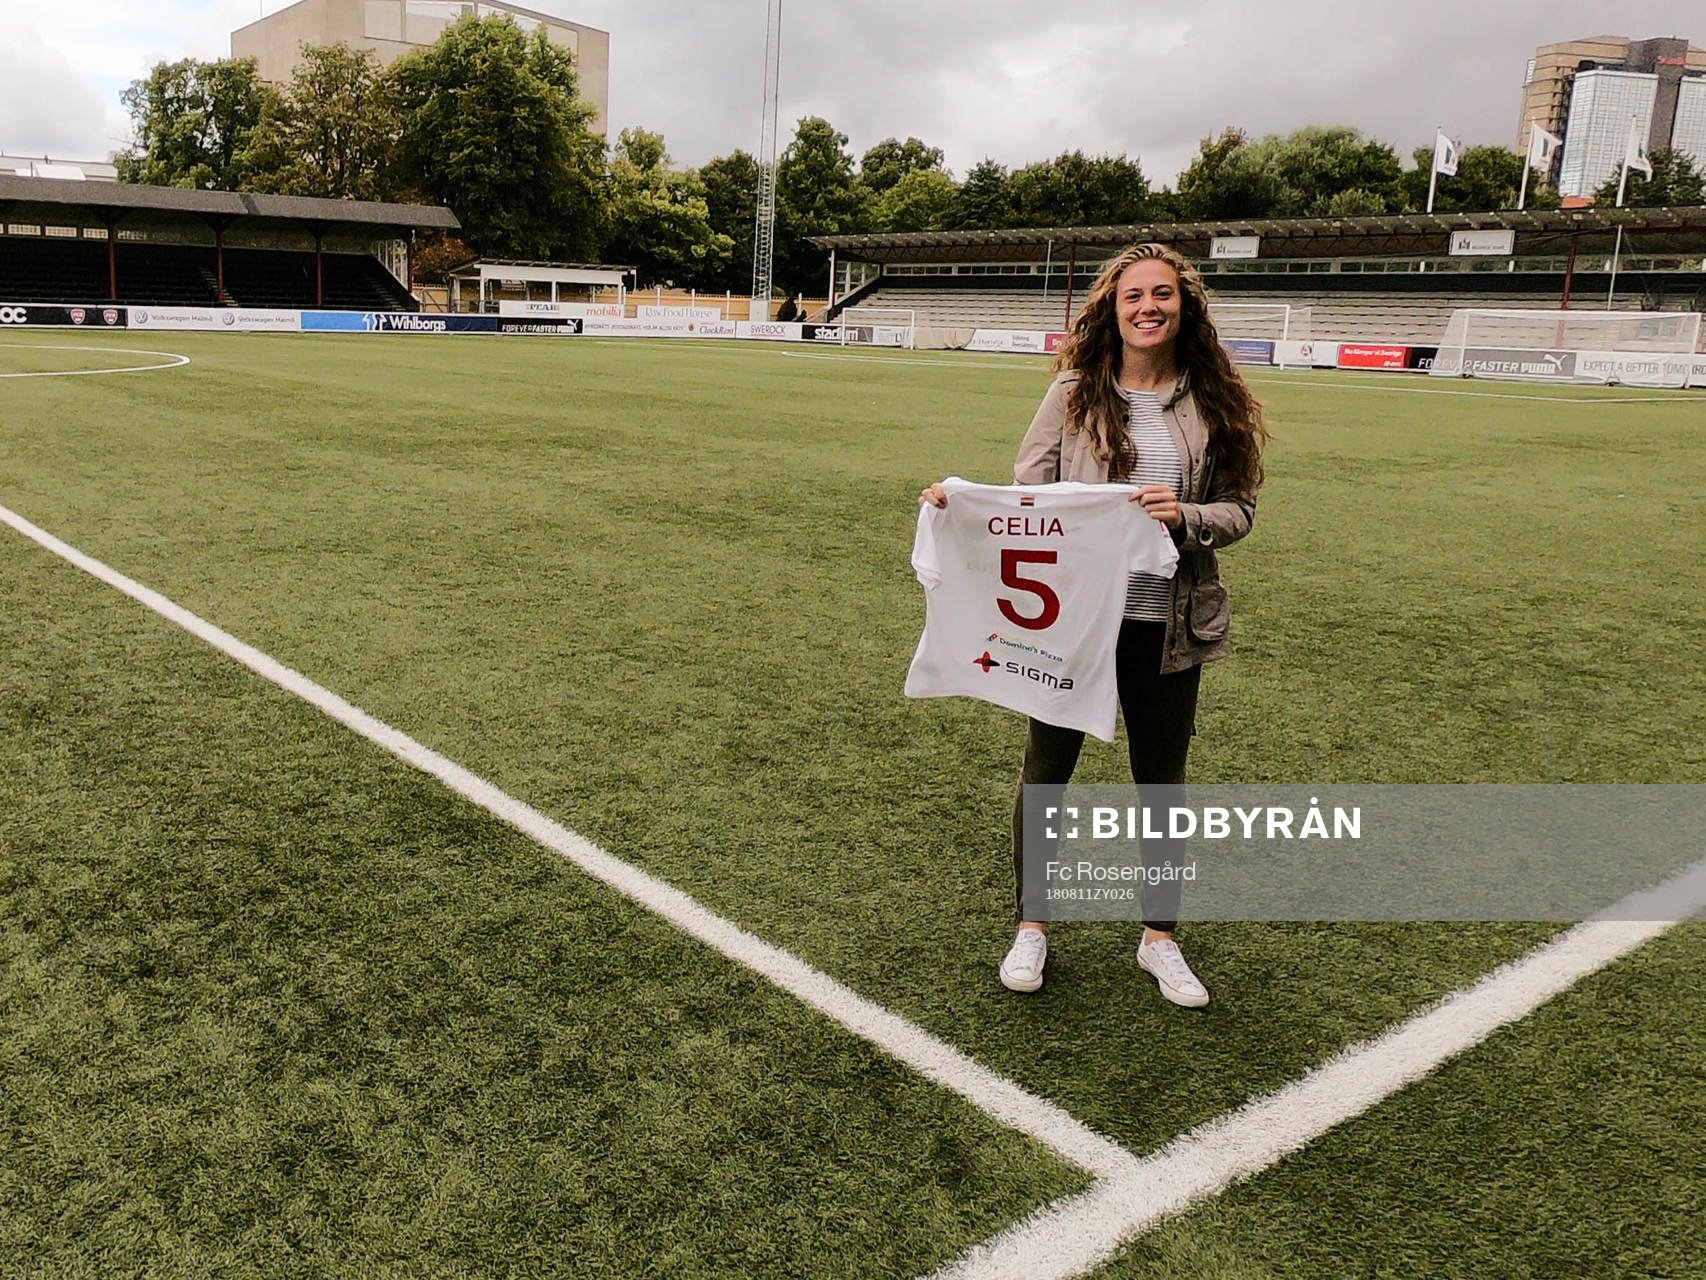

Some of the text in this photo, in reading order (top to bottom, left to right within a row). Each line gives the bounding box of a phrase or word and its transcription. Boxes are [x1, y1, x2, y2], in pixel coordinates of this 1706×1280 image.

[586, 305, 621, 317] mobilia
[663, 307, 684, 318] Food
[685, 307, 713, 319] House
[389, 315, 446, 331] Wihlborgs
[751, 325, 785, 334] SWEROCK
[1472, 360, 1519, 372] FASTER
[1584, 360, 1614, 371] EXPECT
[1616, 362, 1623, 372] A
[1626, 361, 1659, 374] BETTER
[988, 516, 1064, 536] CELIA
[997, 549, 1060, 630] 5
[999, 637, 1063, 662] Domino's Pizza
